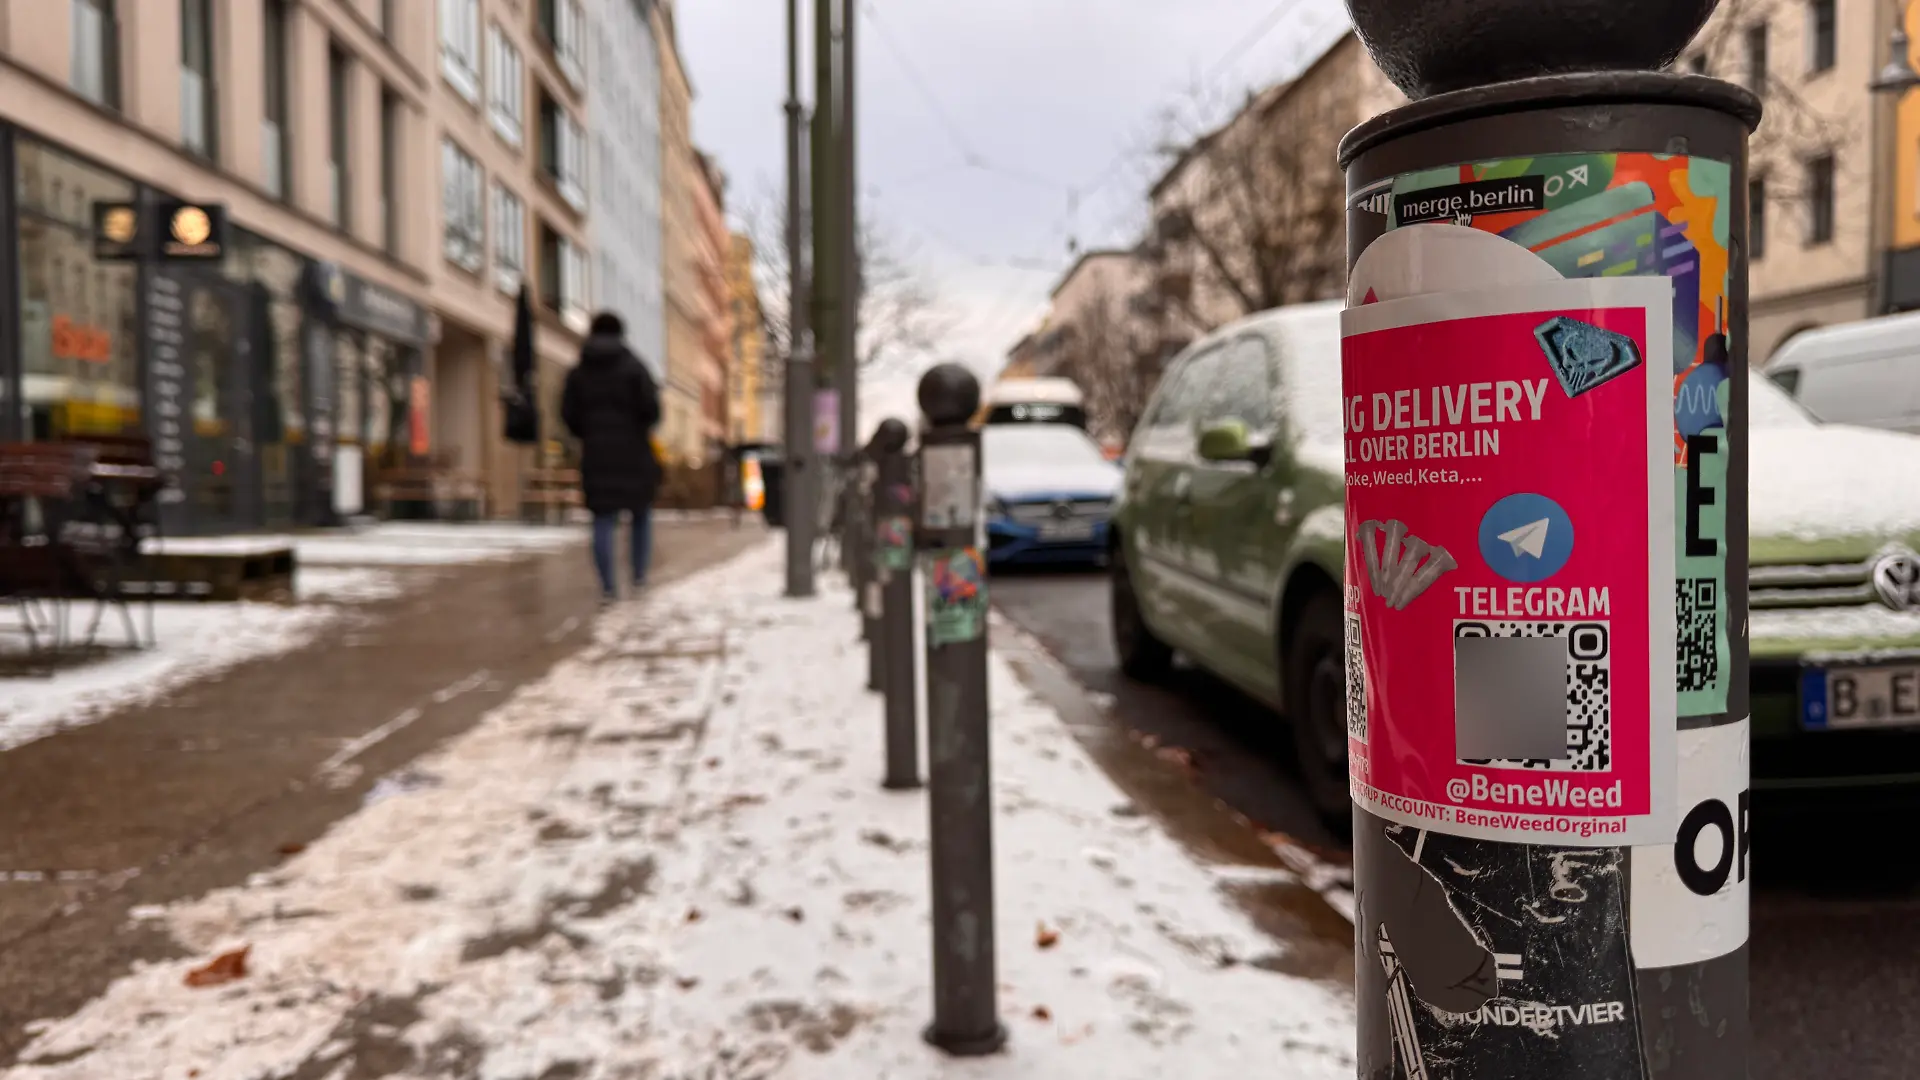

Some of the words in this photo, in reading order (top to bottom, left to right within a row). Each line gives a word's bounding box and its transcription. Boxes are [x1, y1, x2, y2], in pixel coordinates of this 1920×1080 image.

[1403, 184, 1534, 217] merge.berlin
[1372, 378, 1549, 431] DELIVERY
[1360, 435, 1409, 462] OVER
[1414, 428, 1500, 460] BERLIN
[1685, 435, 1718, 558] E
[1453, 586, 1611, 617] TELEGRAM
[1834, 677, 1859, 717] B
[1890, 671, 1920, 715] E
[1446, 773, 1622, 809] @BeneWeed
[1380, 793, 1450, 822] ACCOUNT:
[1455, 809, 1627, 838] BeneWeedOrginal
